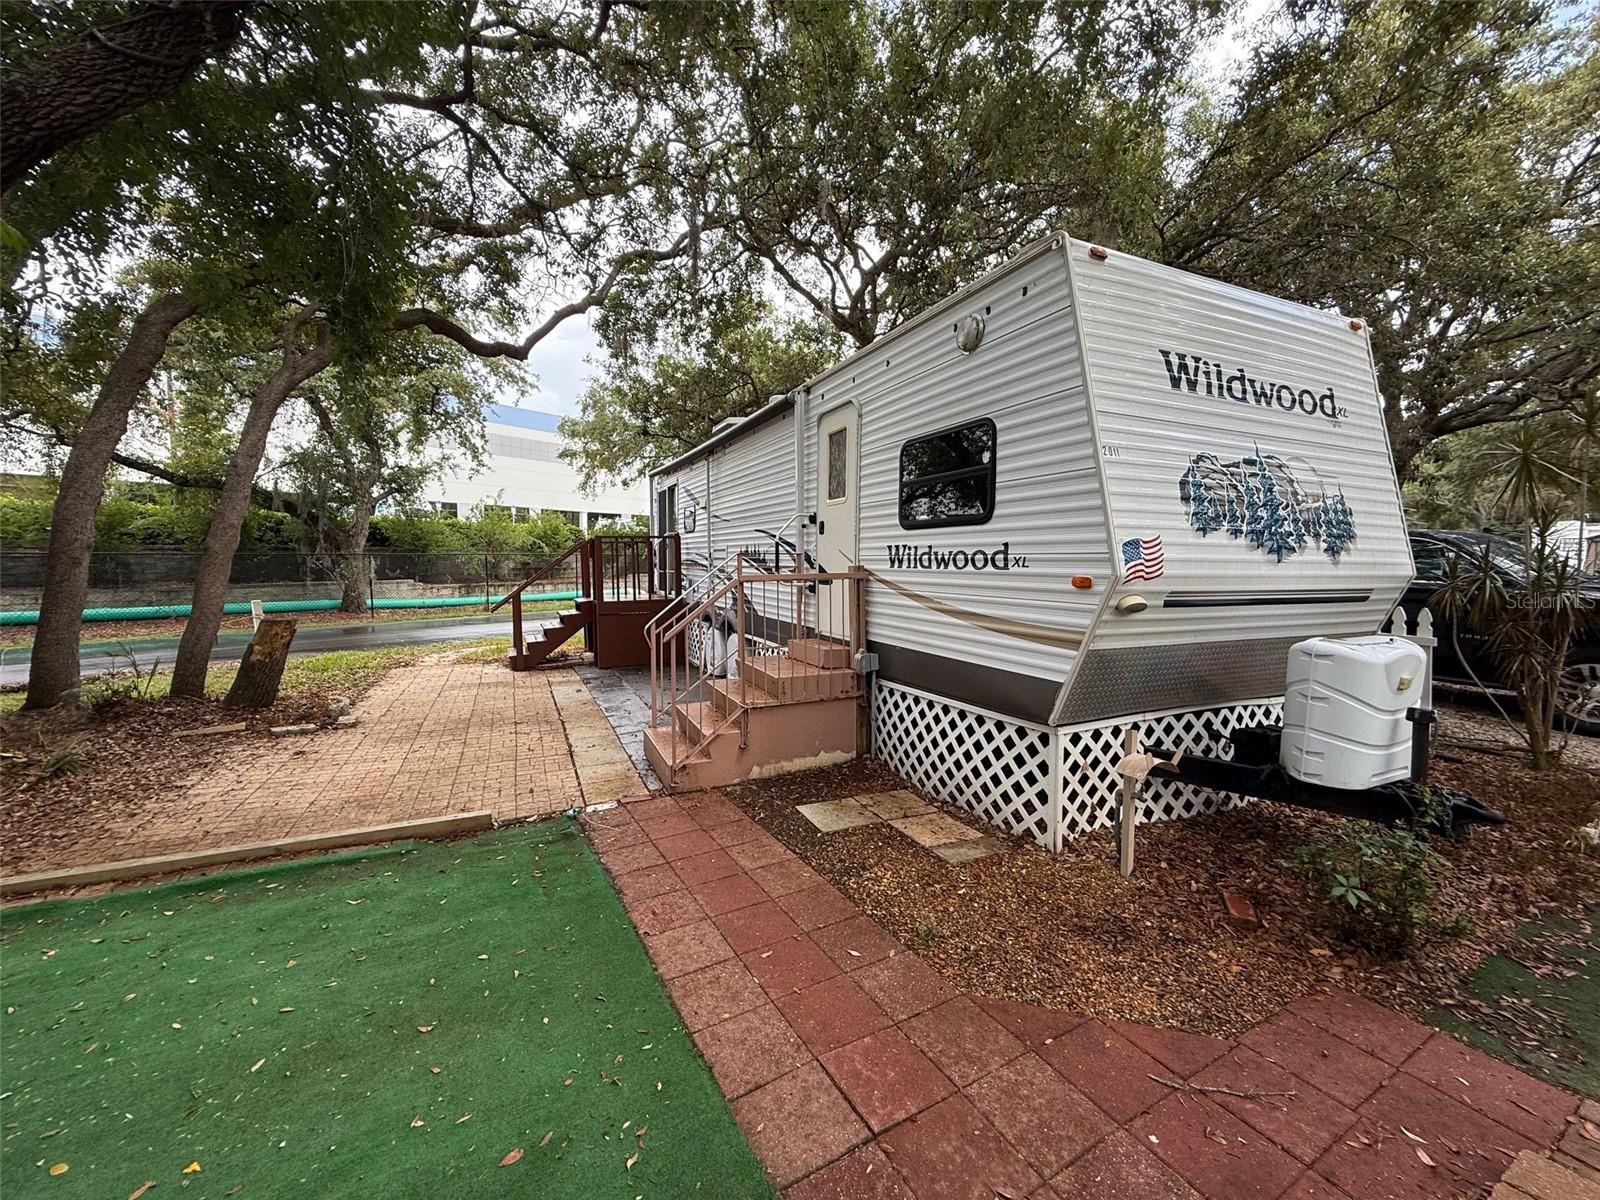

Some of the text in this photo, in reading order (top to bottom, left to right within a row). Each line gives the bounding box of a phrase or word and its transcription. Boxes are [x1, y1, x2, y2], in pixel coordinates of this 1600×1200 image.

[1158, 349, 1349, 419] Wildwood XL
[1102, 445, 1120, 457] 2011
[886, 541, 1030, 571] Wildwood XL
